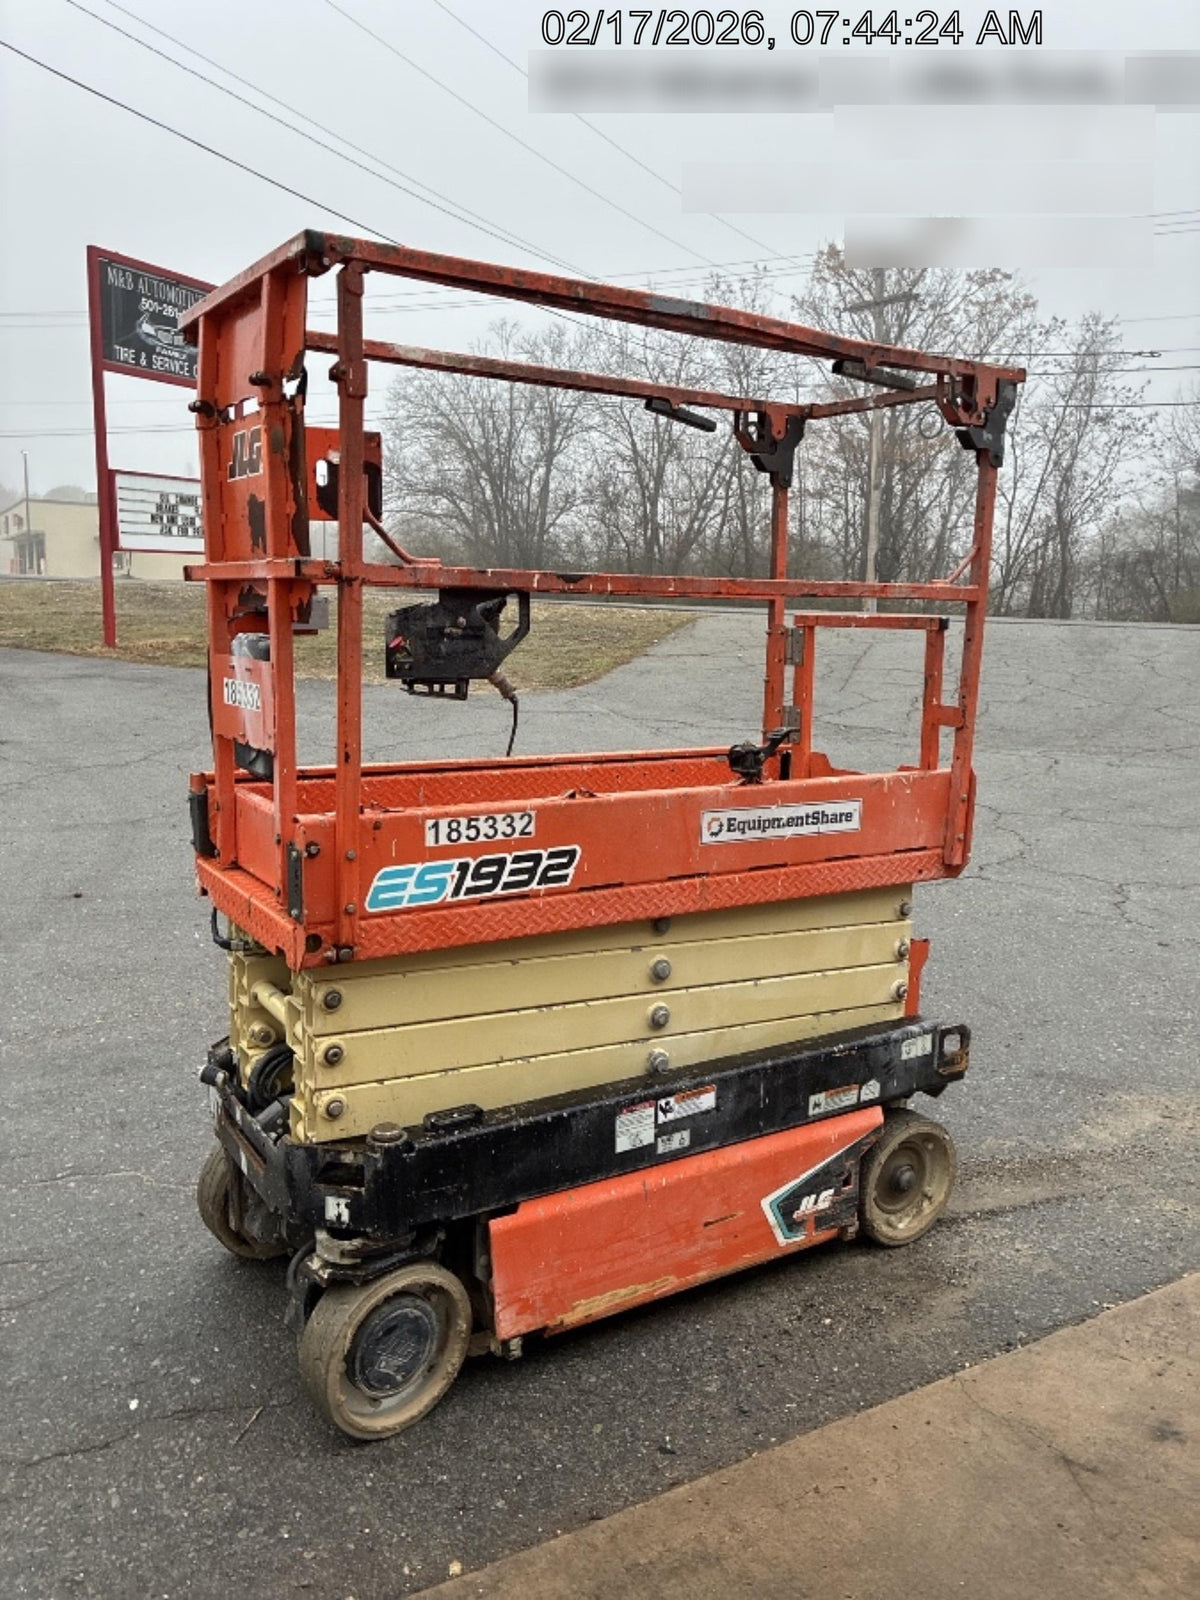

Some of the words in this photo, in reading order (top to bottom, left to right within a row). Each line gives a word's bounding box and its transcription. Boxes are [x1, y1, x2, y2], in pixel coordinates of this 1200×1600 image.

[107, 266, 133, 291] M&B
[114, 345, 136, 365] TIRE
[139, 352, 147, 367] &
[152, 355, 190, 377] SERVICE
[227, 425, 263, 482] JLG
[427, 812, 534, 845] 185332
[726, 810, 853, 835] EquipmentShare
[366, 846, 581, 911] ES1932
[792, 1188, 835, 1220] JLG
